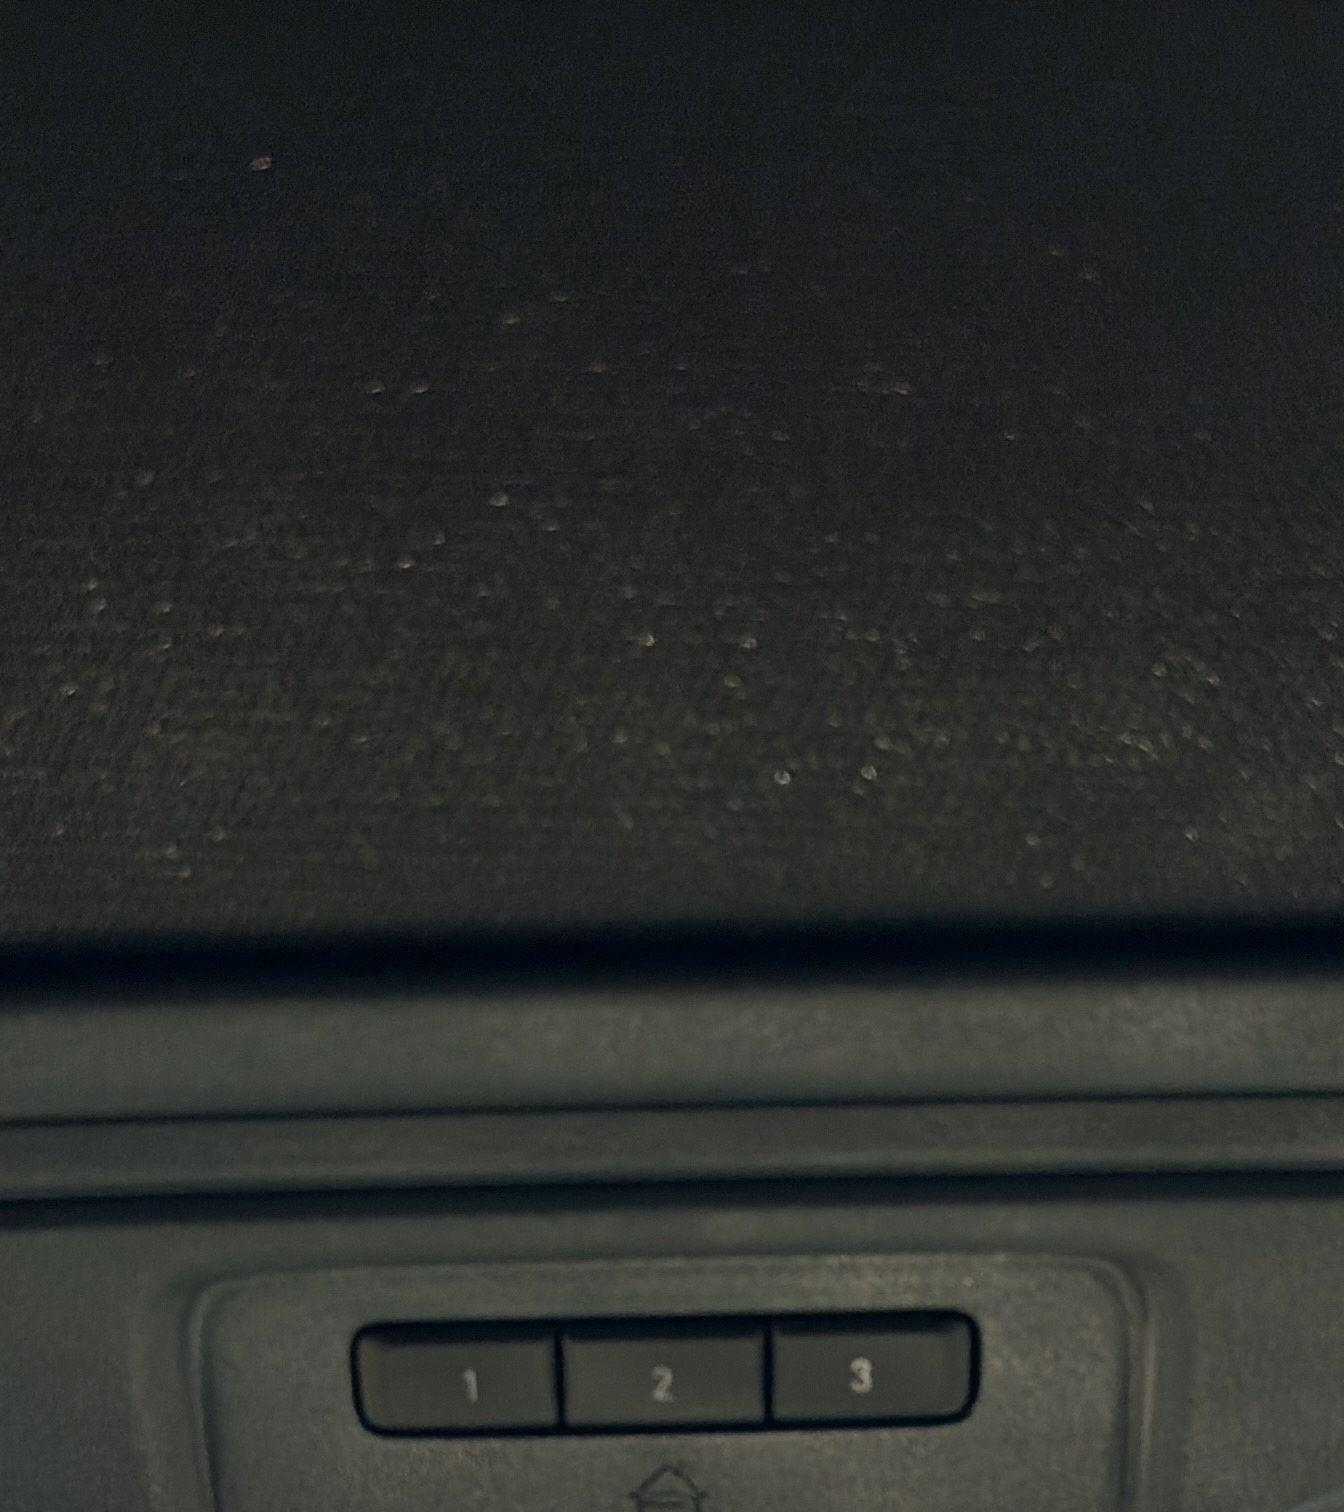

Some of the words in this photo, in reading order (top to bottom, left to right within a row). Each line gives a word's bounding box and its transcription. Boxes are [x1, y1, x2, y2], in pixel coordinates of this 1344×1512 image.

[462, 1368, 479, 1402] 1
[651, 1366, 674, 1402] 2
[849, 1357, 873, 1394] 3
